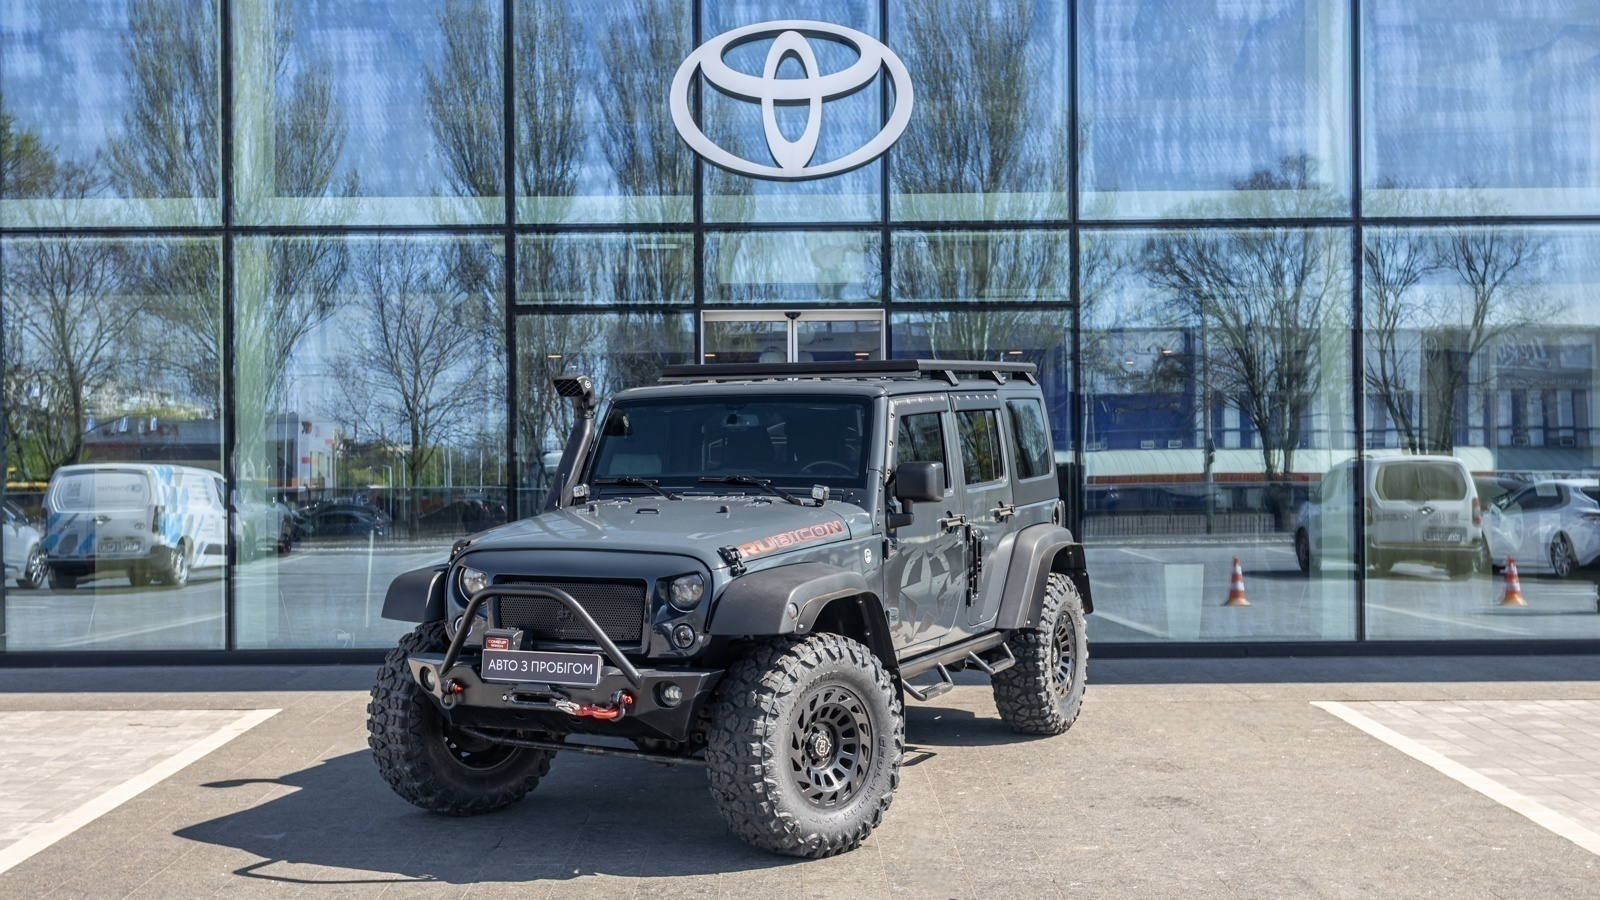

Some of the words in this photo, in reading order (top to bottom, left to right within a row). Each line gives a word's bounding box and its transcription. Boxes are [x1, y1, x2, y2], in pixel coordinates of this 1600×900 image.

[737, 520, 844, 557] RUBICON
[488, 659, 518, 671] АВТО
[531, 661, 593, 674] ПРОБІГОМ
